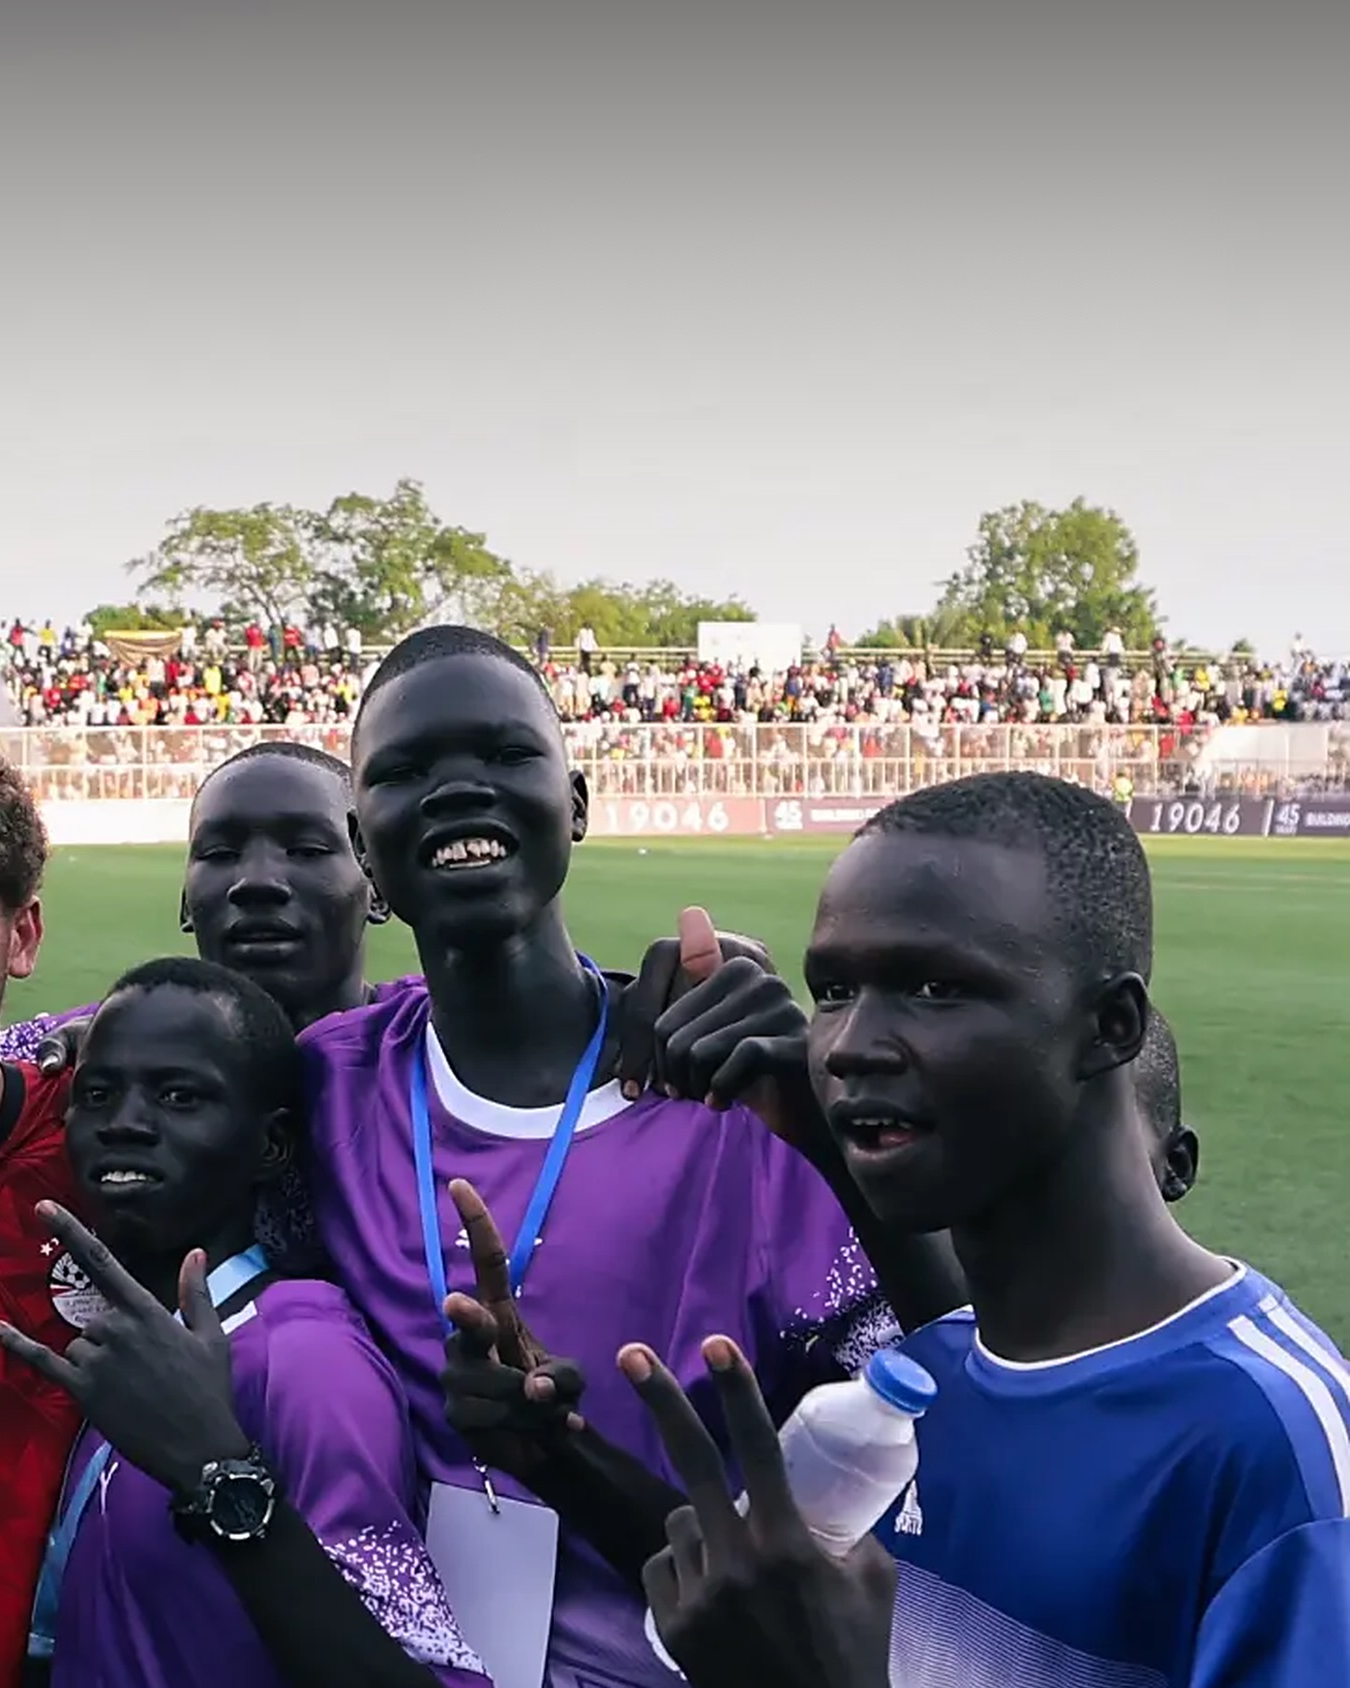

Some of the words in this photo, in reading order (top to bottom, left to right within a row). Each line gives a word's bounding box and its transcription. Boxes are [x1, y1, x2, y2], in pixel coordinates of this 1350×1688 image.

[605, 801, 730, 832] 19046
[1150, 803, 1242, 834] 19046
[1276, 804, 1301, 826] 45
